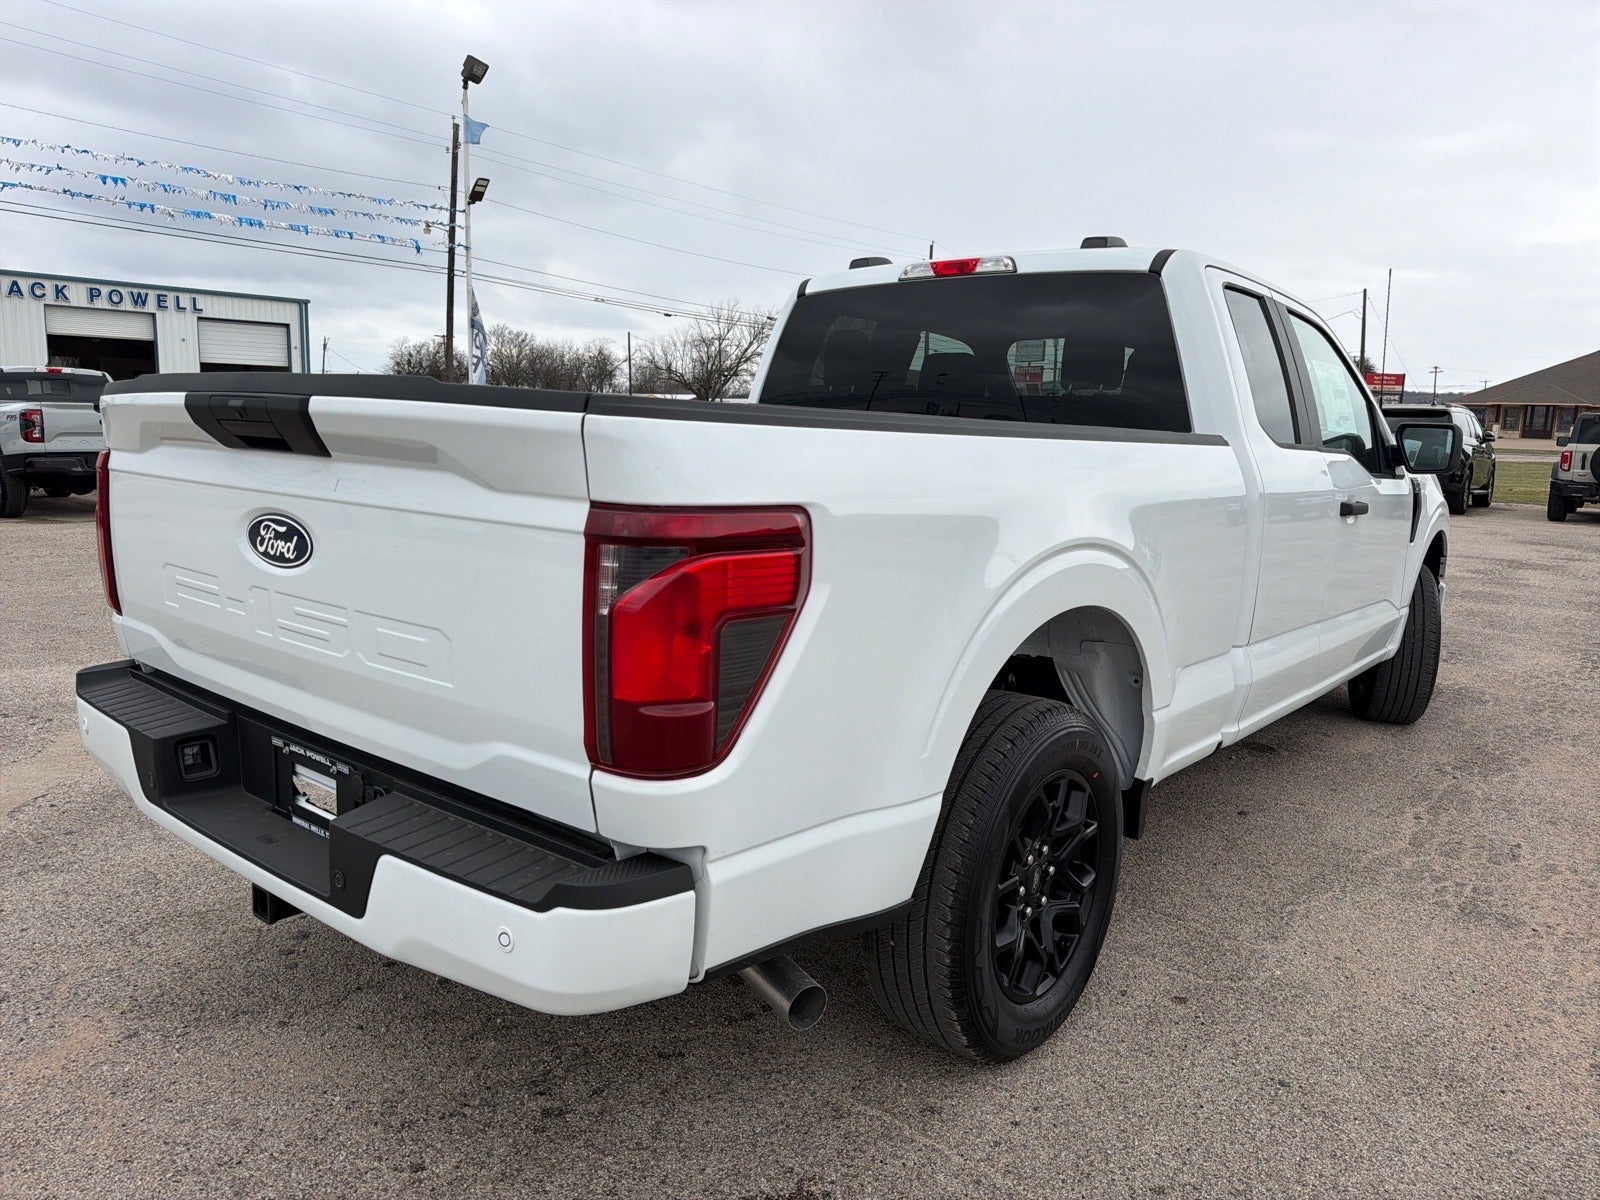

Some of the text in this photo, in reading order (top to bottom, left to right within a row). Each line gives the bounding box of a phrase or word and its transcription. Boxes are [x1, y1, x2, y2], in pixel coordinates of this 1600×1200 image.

[0, 279, 204, 313] ACK POWELL
[257, 519, 298, 560] Ford
[162, 562, 454, 688] F-150
[289, 744, 332, 767] JACK POWELL
